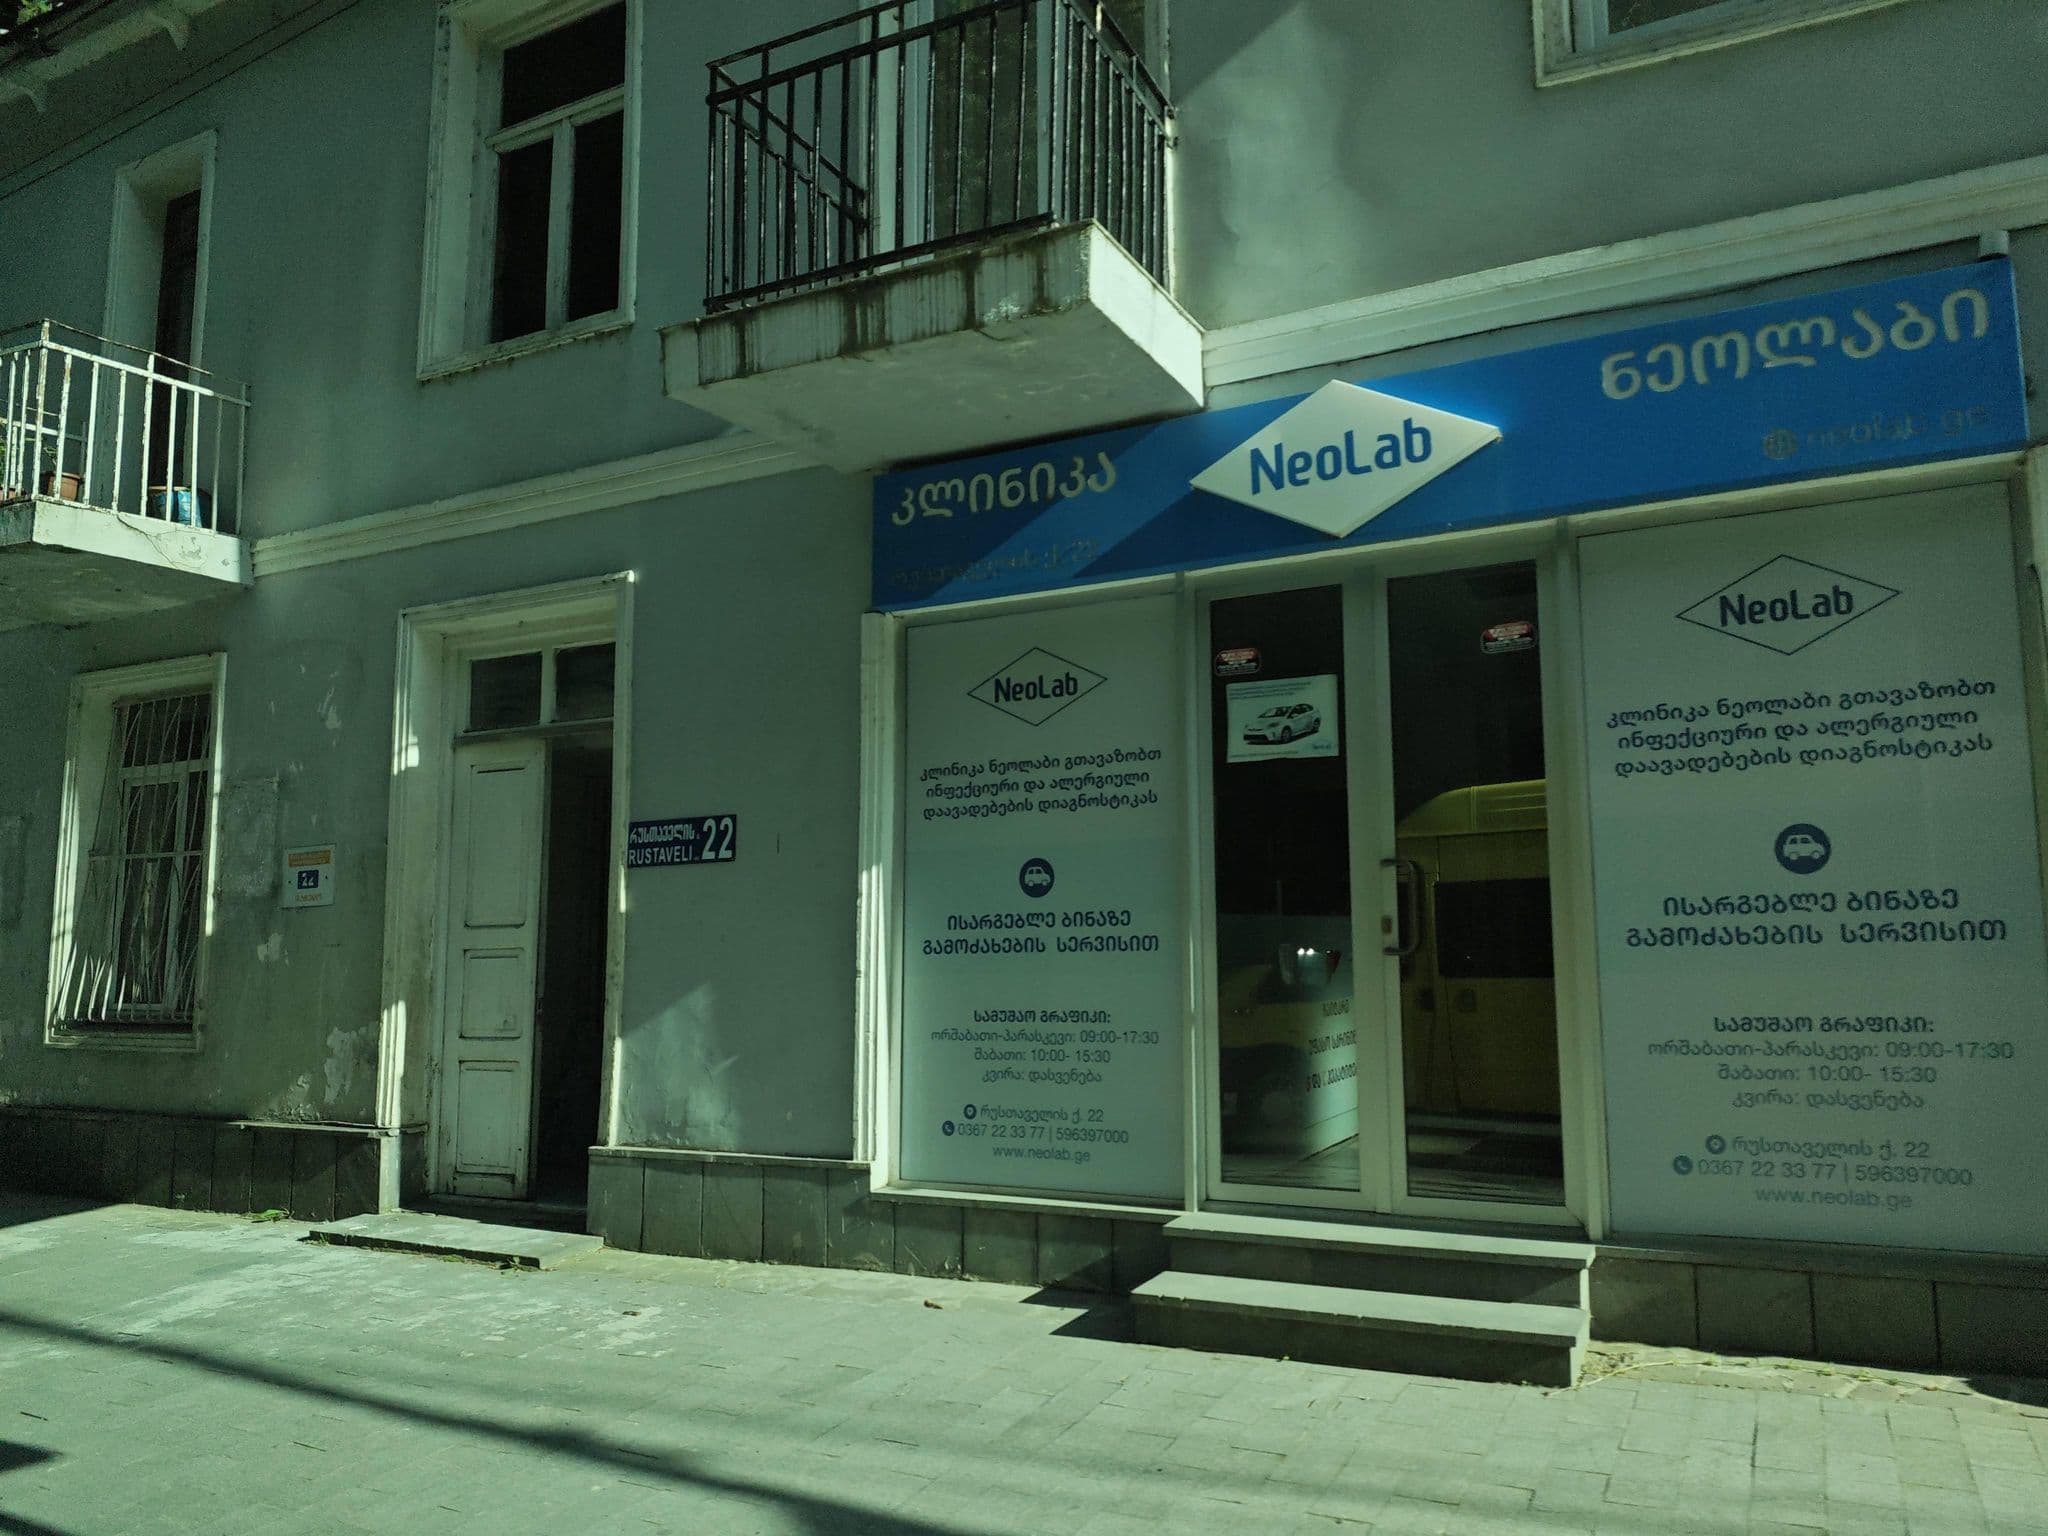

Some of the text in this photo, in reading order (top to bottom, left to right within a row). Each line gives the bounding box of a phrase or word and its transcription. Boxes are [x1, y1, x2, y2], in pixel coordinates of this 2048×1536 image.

[1601, 288, 1990, 400] ნეოლაბი
[1249, 417, 1433, 495] NeoLab
[891, 451, 1117, 527] კლინიკა
[1719, 585, 1854, 627] NeoLab
[994, 671, 1079, 703] NeoLab
[1606, 677, 1996, 729] კლინიკა ნეოლაბი გთავაზობთ
[1618, 707, 1978, 751] ინფექციური და ალერგიული
[920, 747, 1162, 782] კლინიკა ნეოლაბი გთავაზობთ
[1615, 733, 1994, 777] დაავადებების დიაგნოსტიკას
[926, 771, 1150, 800] ინფექციური და ალერგიული
[923, 789, 1158, 820] დაავადებების დიაგნოსტიკას
[629, 823, 695, 843] რუსთაველის
[701, 817, 734, 860] 22
[628, 846, 693, 864] RUSTAVELI
[1662, 887, 1959, 916] ისარგებლე ბინაზე
[947, 909, 1131, 931] ისარგებლე ბინაზე
[1626, 918, 2008, 947] გამოძახების სერვისით
[923, 934, 1160, 955] გამოძახების სერვისით
[974, 1009, 1036, 1023] სამუშაო
[1714, 1015, 1814, 1034] სამუშაო
[1080, 1030, 1160, 1044] 09:00-17:30
[1076, 1050, 1112, 1063] 15:30
[1886, 1041, 2015, 1060] 09:00-17:30
[1028, 1068, 1103, 1085] დასვენება
[1879, 1066, 1937, 1083] 15:30
[1806, 1089, 1924, 1110] დასვენება
[980, 1104, 1069, 1122] რუსთაველის
[1087, 1109, 1104, 1123] 22
[957, 1123, 987, 1136] 0367
[991, 1125, 1006, 1138] 22
[1009, 1126, 1026, 1139] 33
[1030, 1127, 1046, 1139] 77
[1055, 1128, 1129, 1143] 596397000
[992, 1146, 1091, 1164] www.neolab.ge
[1732, 1136, 1872, 1159] რუსთაველის
[1904, 1141, 1930, 1158] 22
[1697, 1159, 1743, 1176] 0367
[1751, 1160, 1775, 1177] 22
[1782, 1162, 1806, 1178] 33
[1812, 1163, 1837, 1179] 77
[1855, 1164, 1973, 1185] 596397000
[1755, 1188, 1913, 1211] www.neolab.ge
